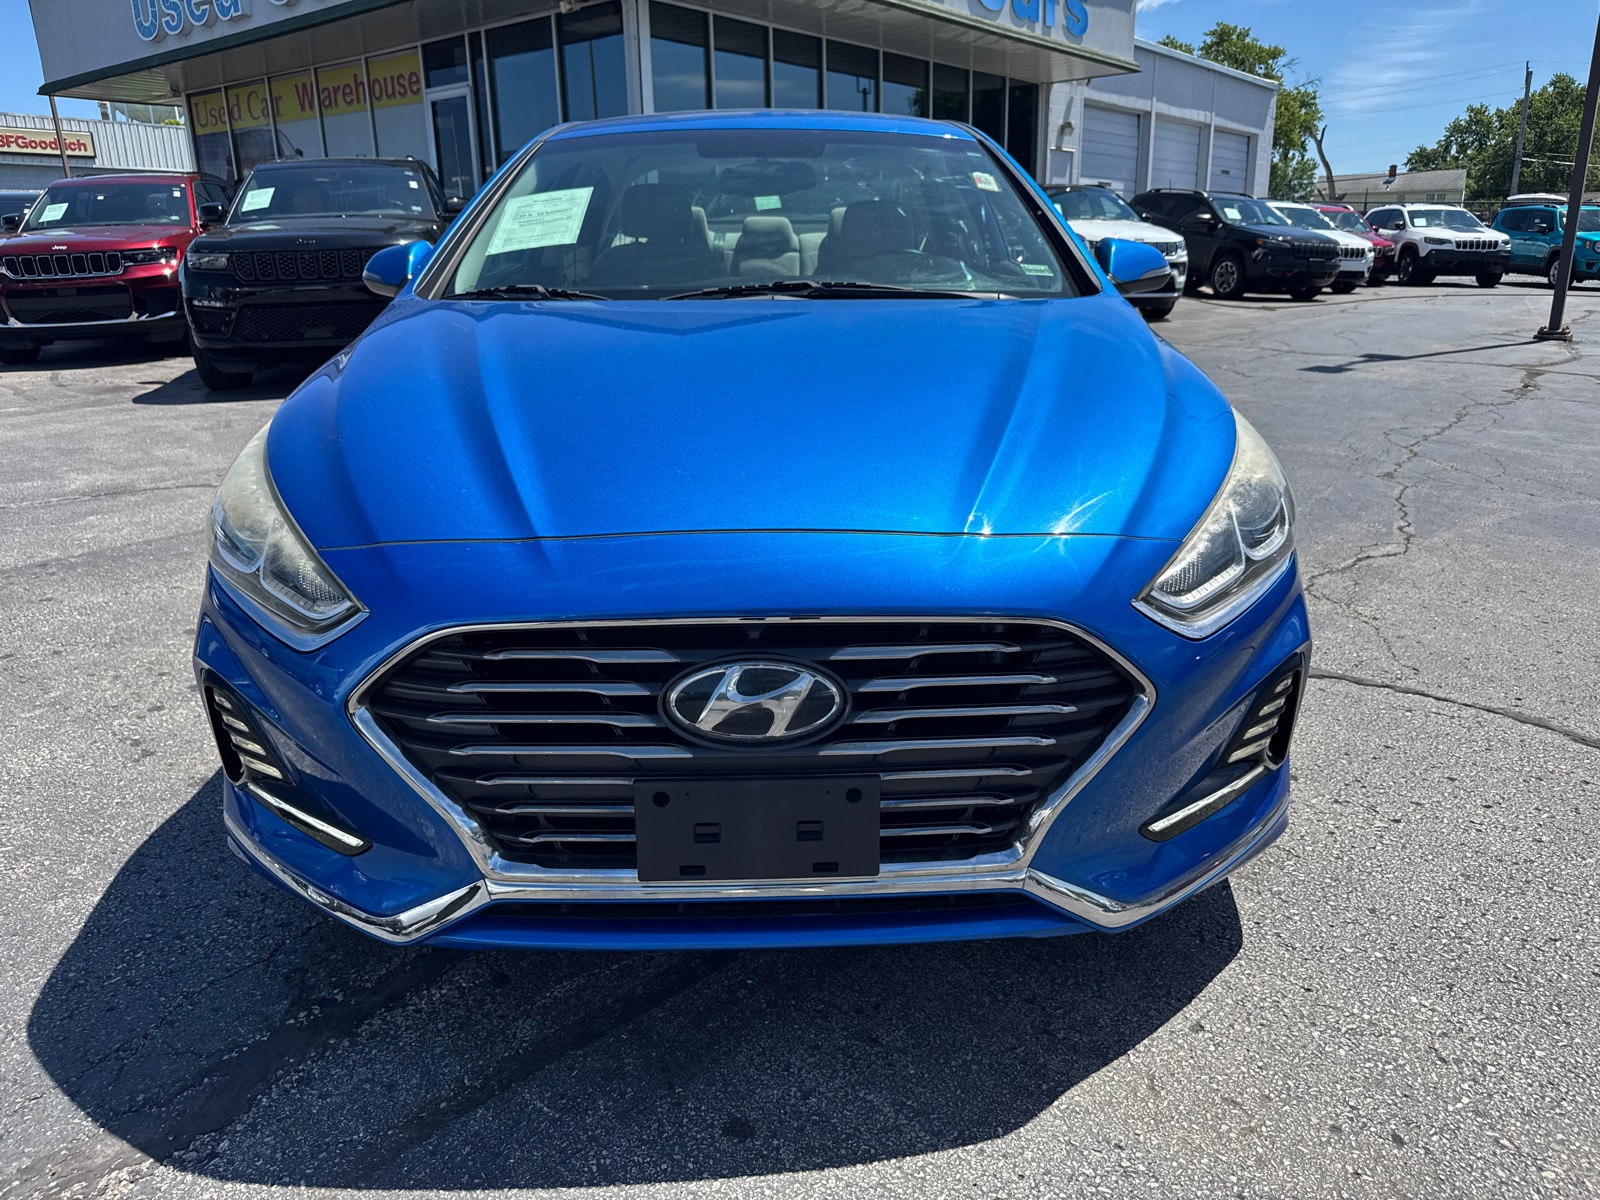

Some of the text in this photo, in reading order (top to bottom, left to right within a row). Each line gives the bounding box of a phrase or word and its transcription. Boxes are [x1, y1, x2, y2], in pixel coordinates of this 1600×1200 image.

[192, 70, 422, 129] Used Car Warehouse
[0, 133, 88, 152] BFGoodich
